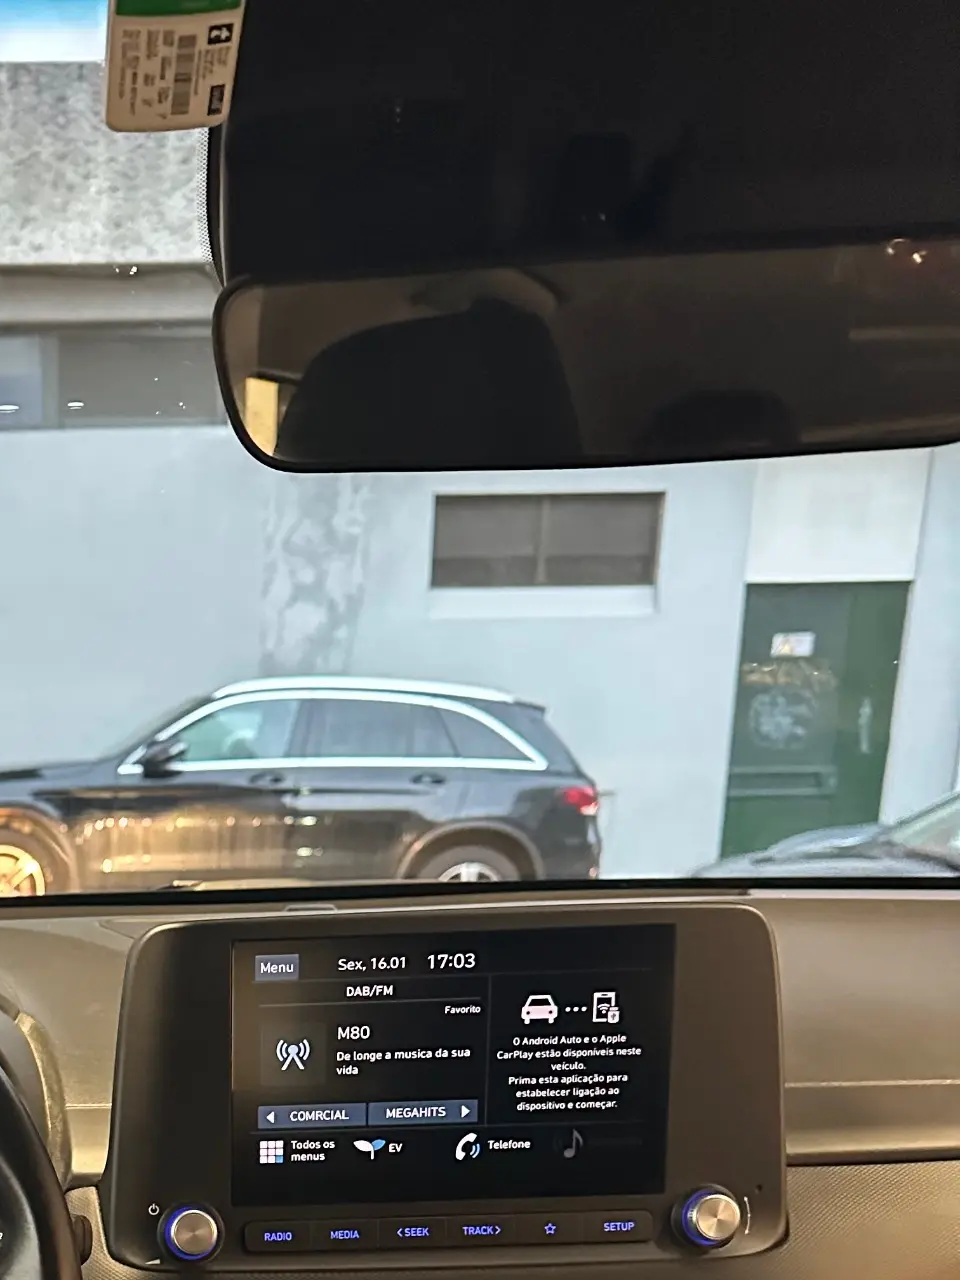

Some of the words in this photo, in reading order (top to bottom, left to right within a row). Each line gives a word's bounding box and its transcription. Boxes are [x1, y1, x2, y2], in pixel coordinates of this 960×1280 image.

[337, 958, 367, 972] Sex,
[370, 957, 406, 970] 16.01
[427, 953, 476, 969] 17:03
[260, 962, 294, 974] Menu
[346, 985, 393, 997] DAB/FM
[444, 1004, 481, 1014] Favorito
[337, 1025, 370, 1040] M80
[512, 1037, 520, 1046] O
[522, 1035, 558, 1046] Android
[559, 1036, 581, 1044] Auto
[599, 1034, 627, 1045] Apple
[336, 1051, 351, 1062] De
[353, 1050, 382, 1062] longe
[384, 1052, 391, 1060] a
[394, 1049, 432, 1059] musica
[434, 1048, 449, 1058] da
[451, 1049, 471, 1057] sua
[496, 1050, 533, 1060] CarPlay
[535, 1049, 561, 1058] estão
[562, 1047, 614, 1058] disponíveis
[616, 1047, 642, 1056] neste
[336, 1065, 359, 1075] vida
[551, 1062, 587, 1071] veículo.
[508, 1076, 536, 1085] Prima
[538, 1076, 559, 1084] esta
[560, 1073, 604, 1085] aplicação
[606, 1074, 629, 1084] para
[515, 1088, 570, 1098] estabelecer
[572, 1086, 606, 1097] ligação
[517, 1101, 565, 1112] dispositivo
[575, 1100, 618, 1110] começar.
[289, 1109, 350, 1122] COMRCIAL
[386, 1107, 447, 1119] MEGAHITS
[290, 1139, 321, 1150] Todos
[323, 1141, 336, 1149] os
[388, 1143, 403, 1153] EV
[487, 1139, 531, 1150] Telefone
[290, 1152, 326, 1162] menus
[404, 1227, 429, 1237] SEEK
[462, 1226, 493, 1235] TRACK
[603, 1221, 635, 1232] SETUP
[264, 1231, 292, 1241] RADIO
[330, 1229, 360, 1239] MEDIA
